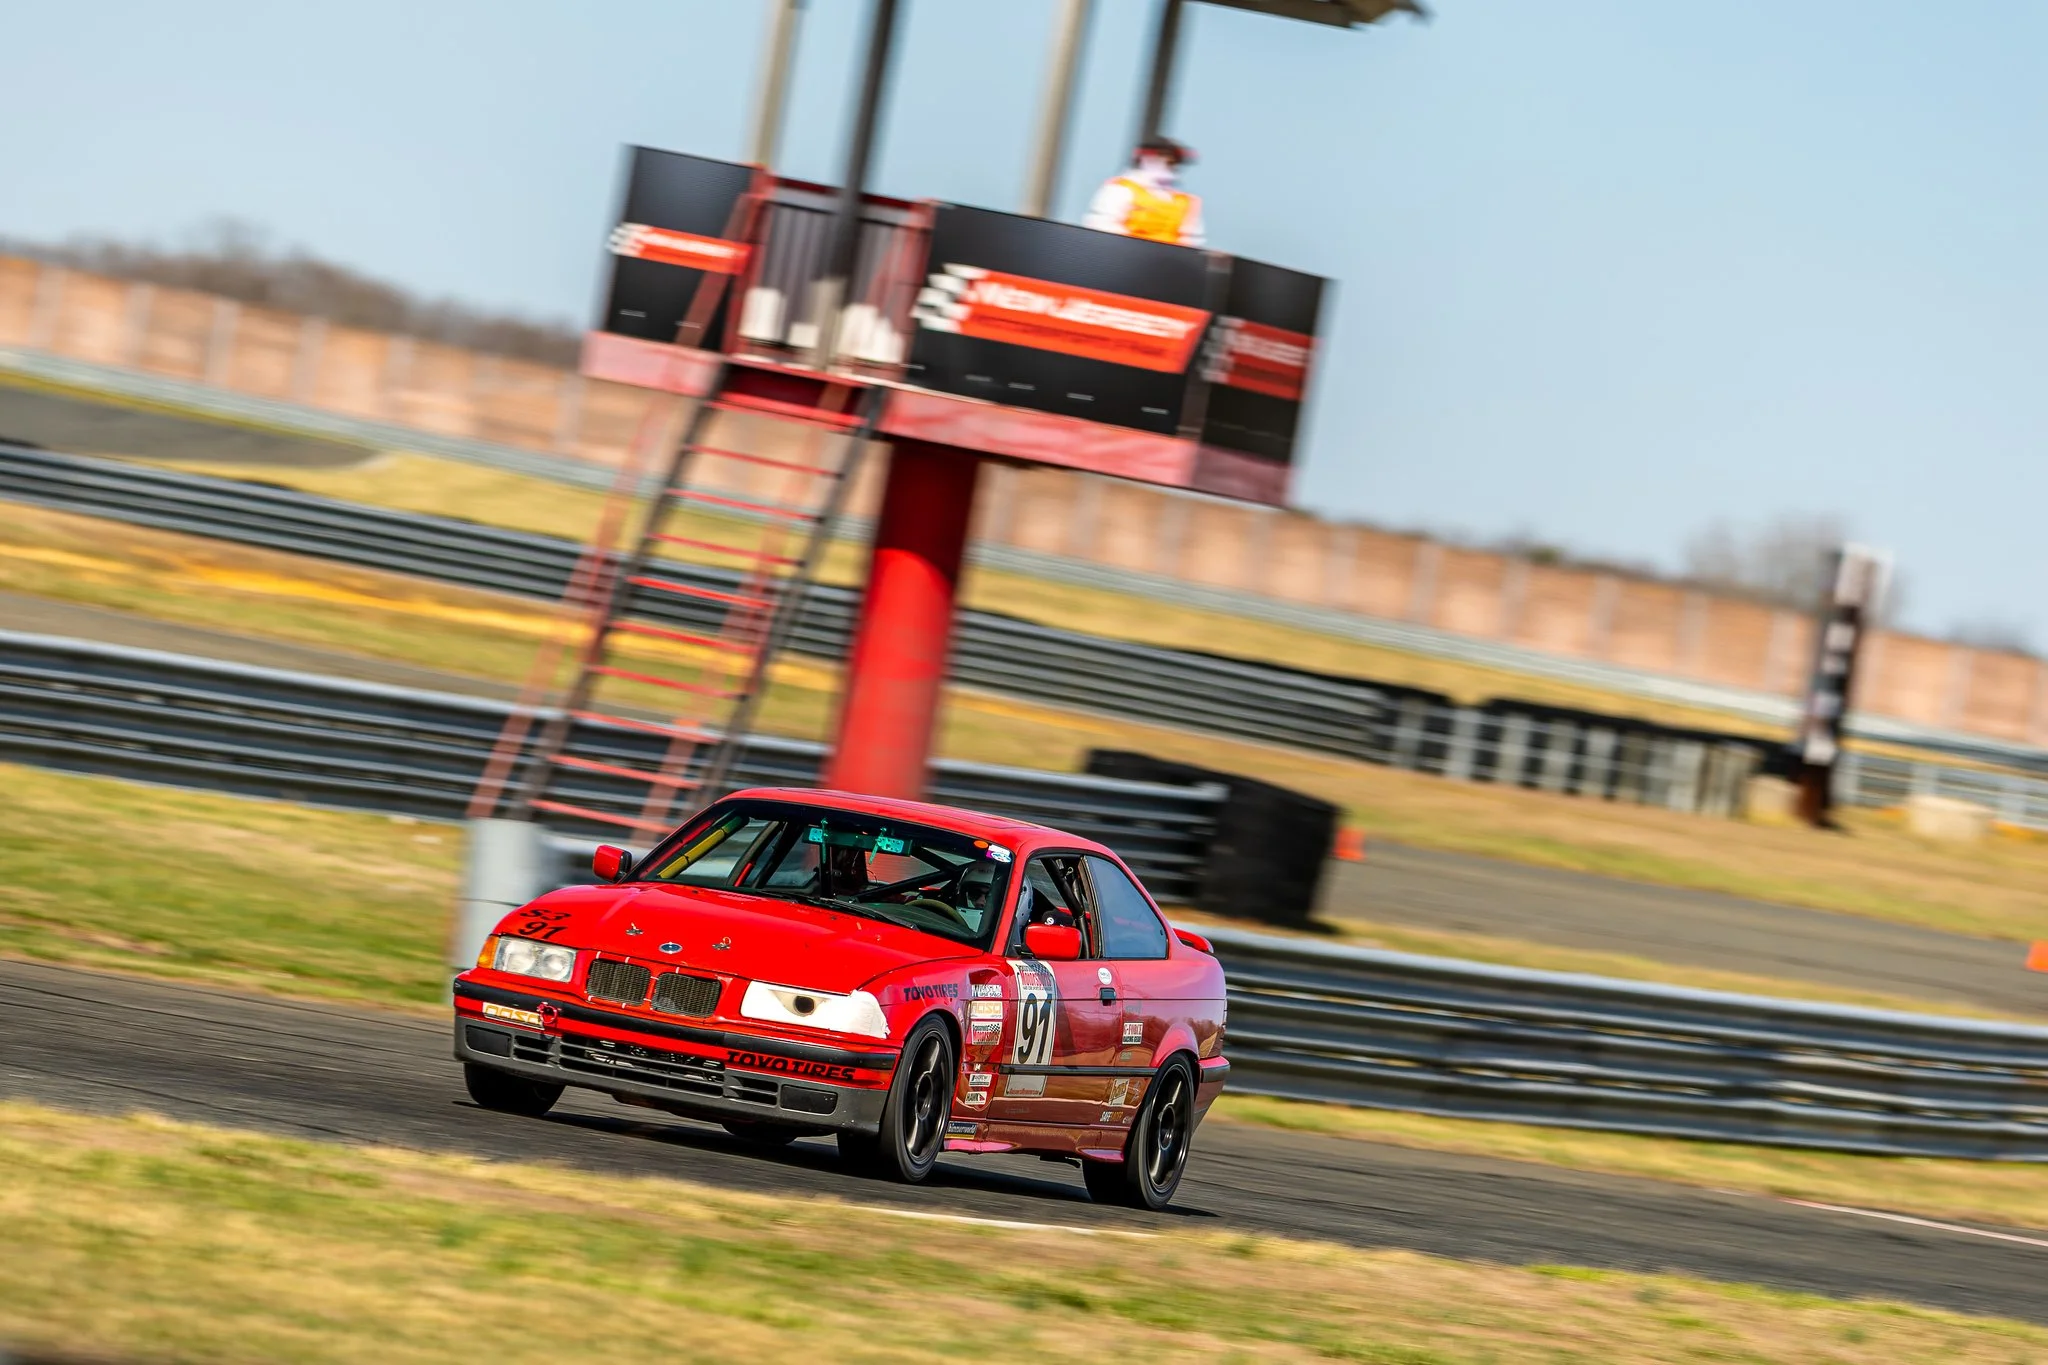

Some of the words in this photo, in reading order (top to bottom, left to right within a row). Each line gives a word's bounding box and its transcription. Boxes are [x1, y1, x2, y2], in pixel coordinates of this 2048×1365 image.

[520, 909, 571, 920] S3
[518, 921, 568, 939] 91
[1018, 993, 1052, 1064] 91
